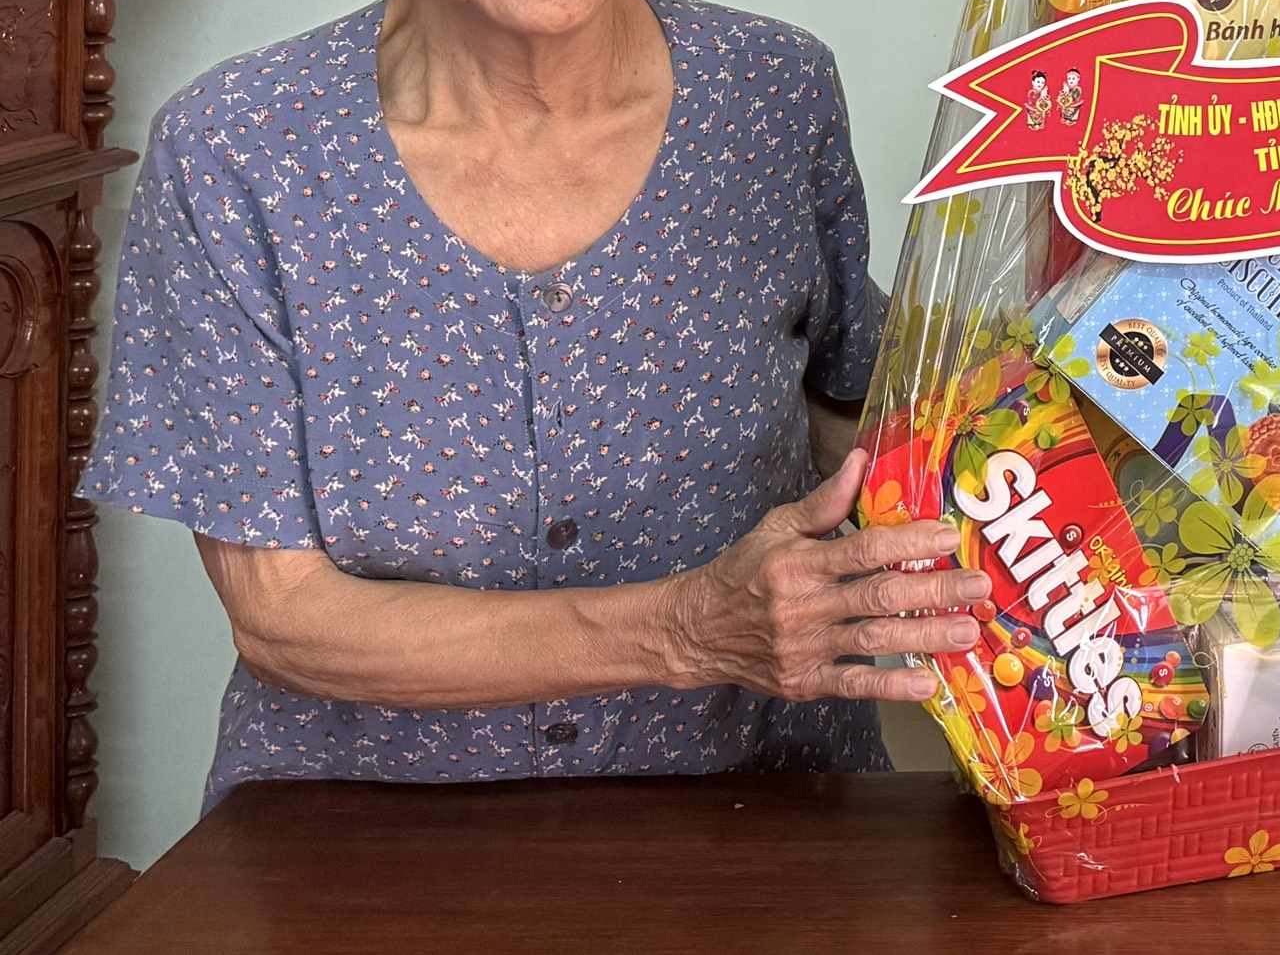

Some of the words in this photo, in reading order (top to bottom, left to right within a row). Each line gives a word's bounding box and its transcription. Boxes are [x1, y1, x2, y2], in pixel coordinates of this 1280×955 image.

[1207, 19, 1264, 41] Bánh
[1157, 95, 1203, 135] TỈNH
[1208, 95, 1233, 136] ỦY
[1167, 187, 1252, 222] Chúc
[1179, 277, 1216, 312] Original
[1217, 278, 1242, 302] Product
[1239, 298, 1249, 308] of
[1245, 304, 1274, 331] Thailand
[1127, 321, 1146, 330] BEST
[1110, 334, 1152, 373] PREMIUM
[953, 448, 1143, 737] Skittles
